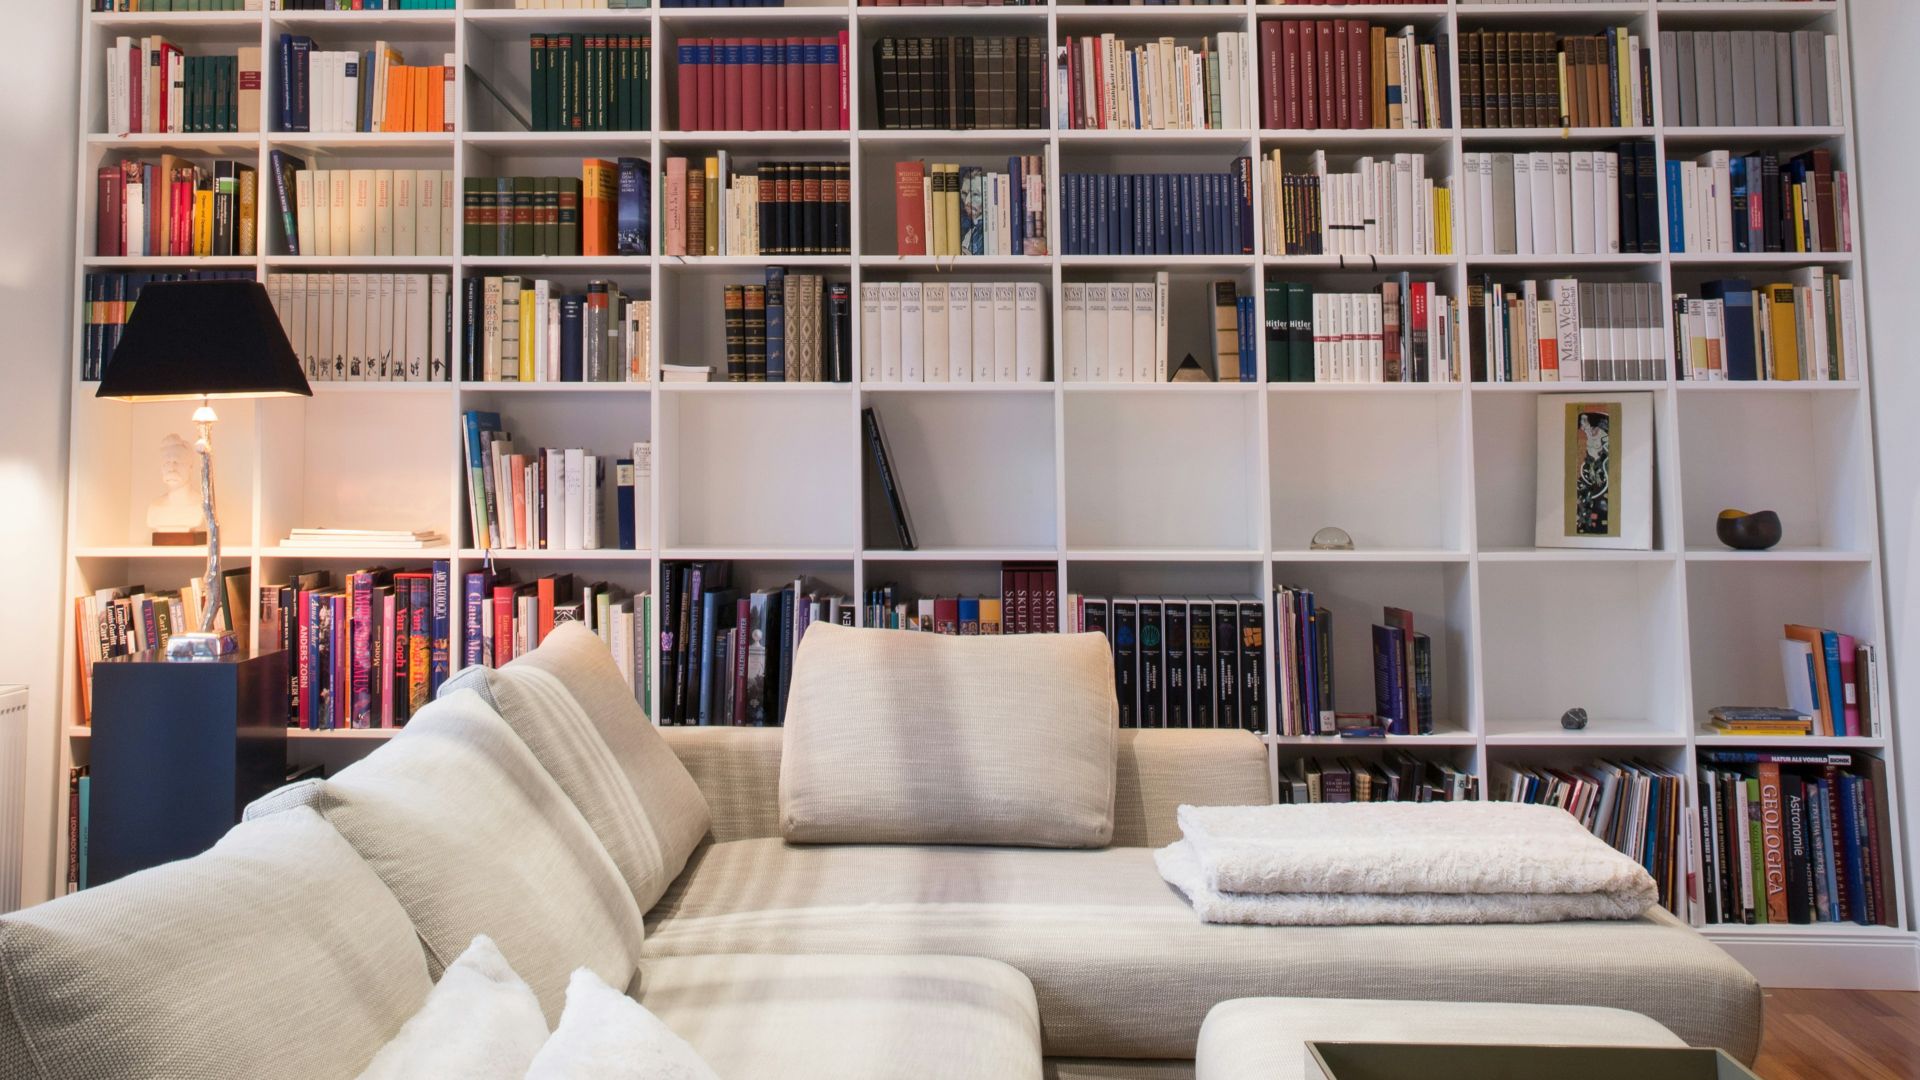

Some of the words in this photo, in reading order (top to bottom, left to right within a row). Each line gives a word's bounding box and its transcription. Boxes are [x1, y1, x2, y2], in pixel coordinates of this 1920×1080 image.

[1559, 286, 1571, 328] Weber
[1561, 332, 1573, 362] Max
[107, 605, 115, 624] Louis
[144, 607, 155, 644] TURNER
[159, 614, 167, 631] Carl
[396, 608, 407, 630] Van
[413, 608, 424, 630] Van
[468, 592, 481, 636] Claude
[1006, 591, 1014, 634] SKULPT
[1017, 590, 1027, 633] SKULPT
[100, 623, 109, 640] Carl
[396, 635, 407, 667] Gogh
[410, 635, 424, 667] Gogh
[413, 672, 424, 682] II
[1763, 785, 1783, 896] GEOLOGICA
[1790, 795, 1804, 856] Astronomie
[70, 854, 77, 863] DA
[1752, 825, 1760, 870] EVOLUTION
